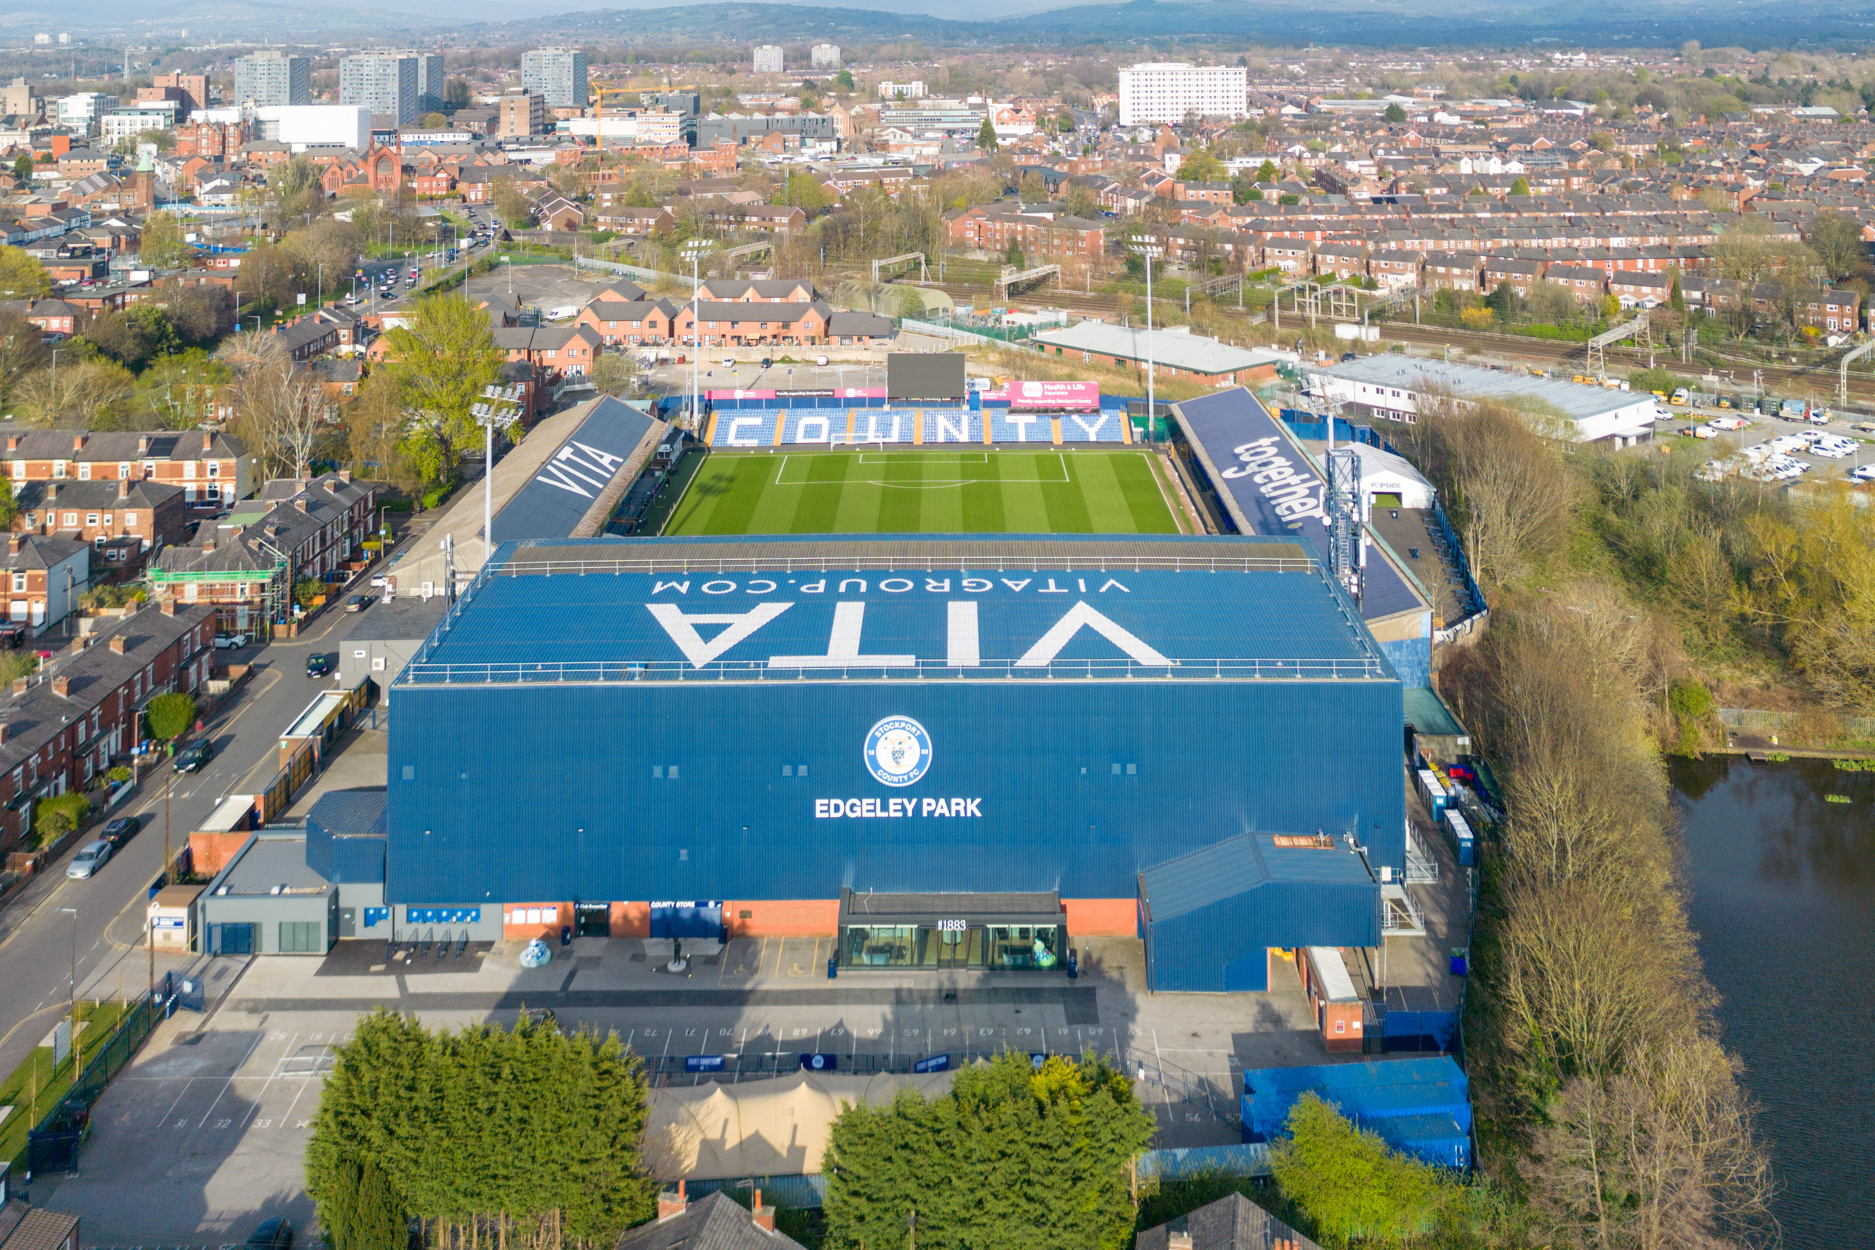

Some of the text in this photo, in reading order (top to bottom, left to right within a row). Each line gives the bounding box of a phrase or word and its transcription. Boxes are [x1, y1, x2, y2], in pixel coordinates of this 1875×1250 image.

[727, 415, 1109, 447] COUNTY
[535, 440, 624, 499] VITA
[651, 578, 1131, 595] VITAGROUP.COM
[645, 600, 1180, 669] VITA
[874, 721, 922, 738] STOCKPORT
[877, 768, 920, 783] COUNTY FC
[815, 798, 982, 818] EDGELEY PARK
[943, 919, 967, 931] 1883
[793, 1028, 807, 1036] 68
[830, 1028, 844, 1036] 67
[867, 1028, 882, 1036] 66
[979, 1028, 993, 1036] 63
[1016, 1028, 1031, 1036] 62
[213, 1118, 232, 1128] 32
[252, 1118, 272, 1128] 33
[1185, 1113, 1201, 1122] 56
